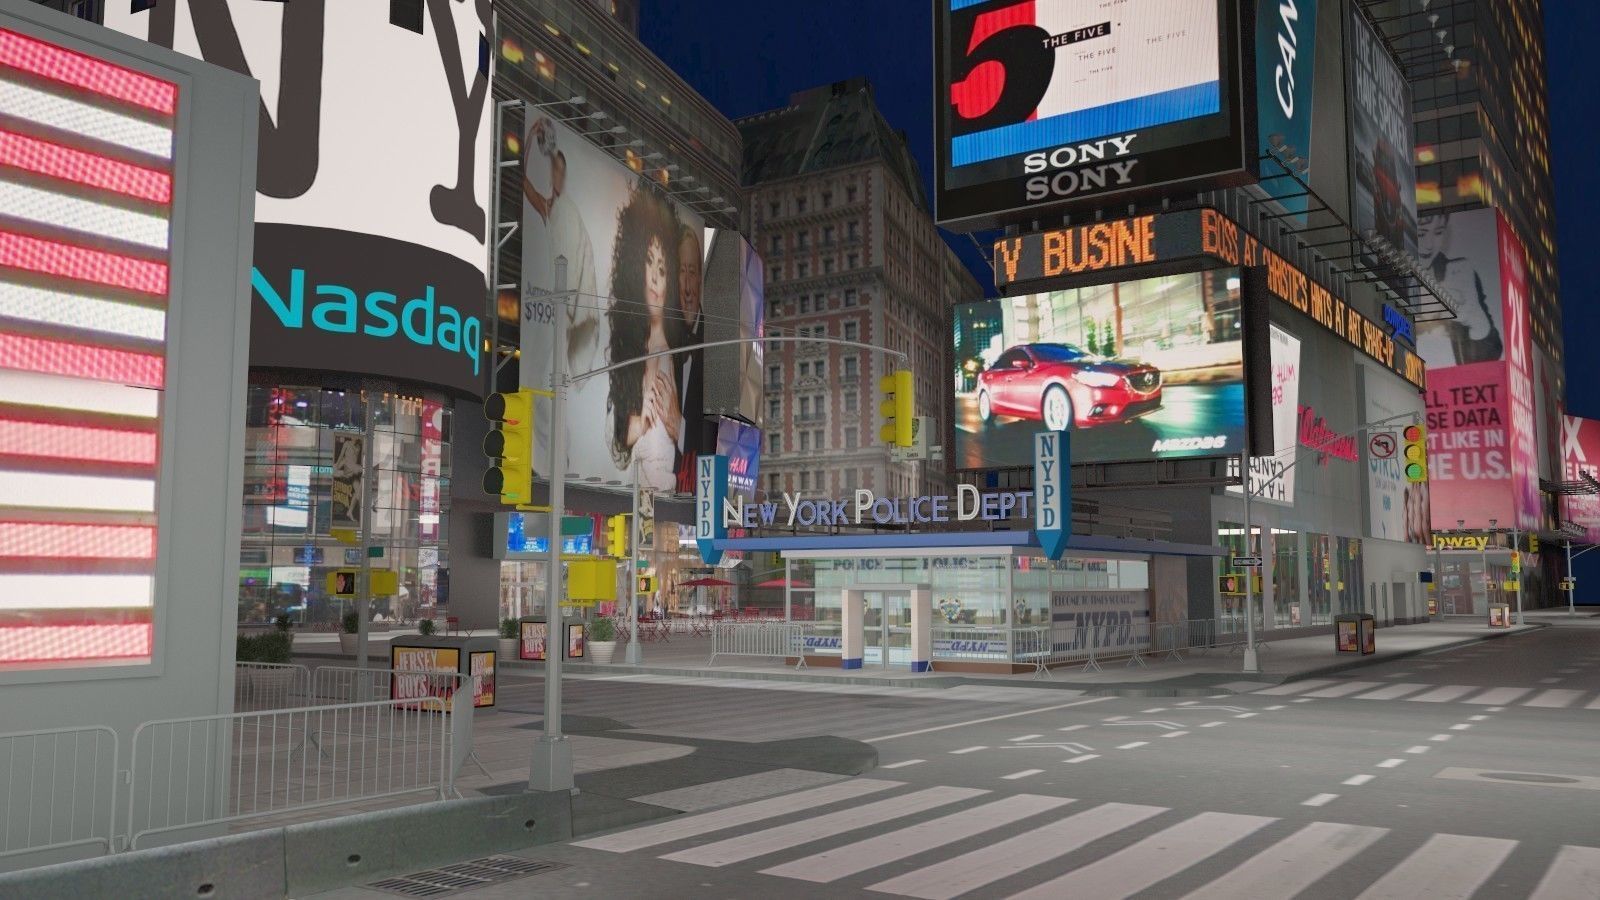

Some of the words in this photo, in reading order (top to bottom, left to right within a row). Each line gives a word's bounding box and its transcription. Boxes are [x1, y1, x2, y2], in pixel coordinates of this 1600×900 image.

[1042, 35, 1068, 49] THE
[1074, 25, 1104, 42] FIVE
[1078, 51, 1094, 61] THE
[1098, 47, 1117, 56] FIVE
[1145, 35, 1163, 45] THE
[1166, 30, 1187, 40] FIVE
[1024, 134, 1137, 174] SONY
[1026, 160, 1139, 201] SONY
[1043, 214, 1155, 277] BUSINE
[251, 266, 480, 377] Nasdaq
[1335, 298, 1345, 338] AT
[1450, 384, 1499, 405] TEXT
[1427, 413, 1449, 430] SE
[1454, 407, 1502, 428] DATA
[1444, 430, 1480, 450] LIKE
[1484, 429, 1504, 447] IN
[1041, 435, 1055, 528] NYPD
[1460, 450, 1511, 480] U.S.
[701, 458, 711, 538] NYPD
[1074, 610, 1132, 650] NYPD
[396, 650, 438, 671] JERSEY
